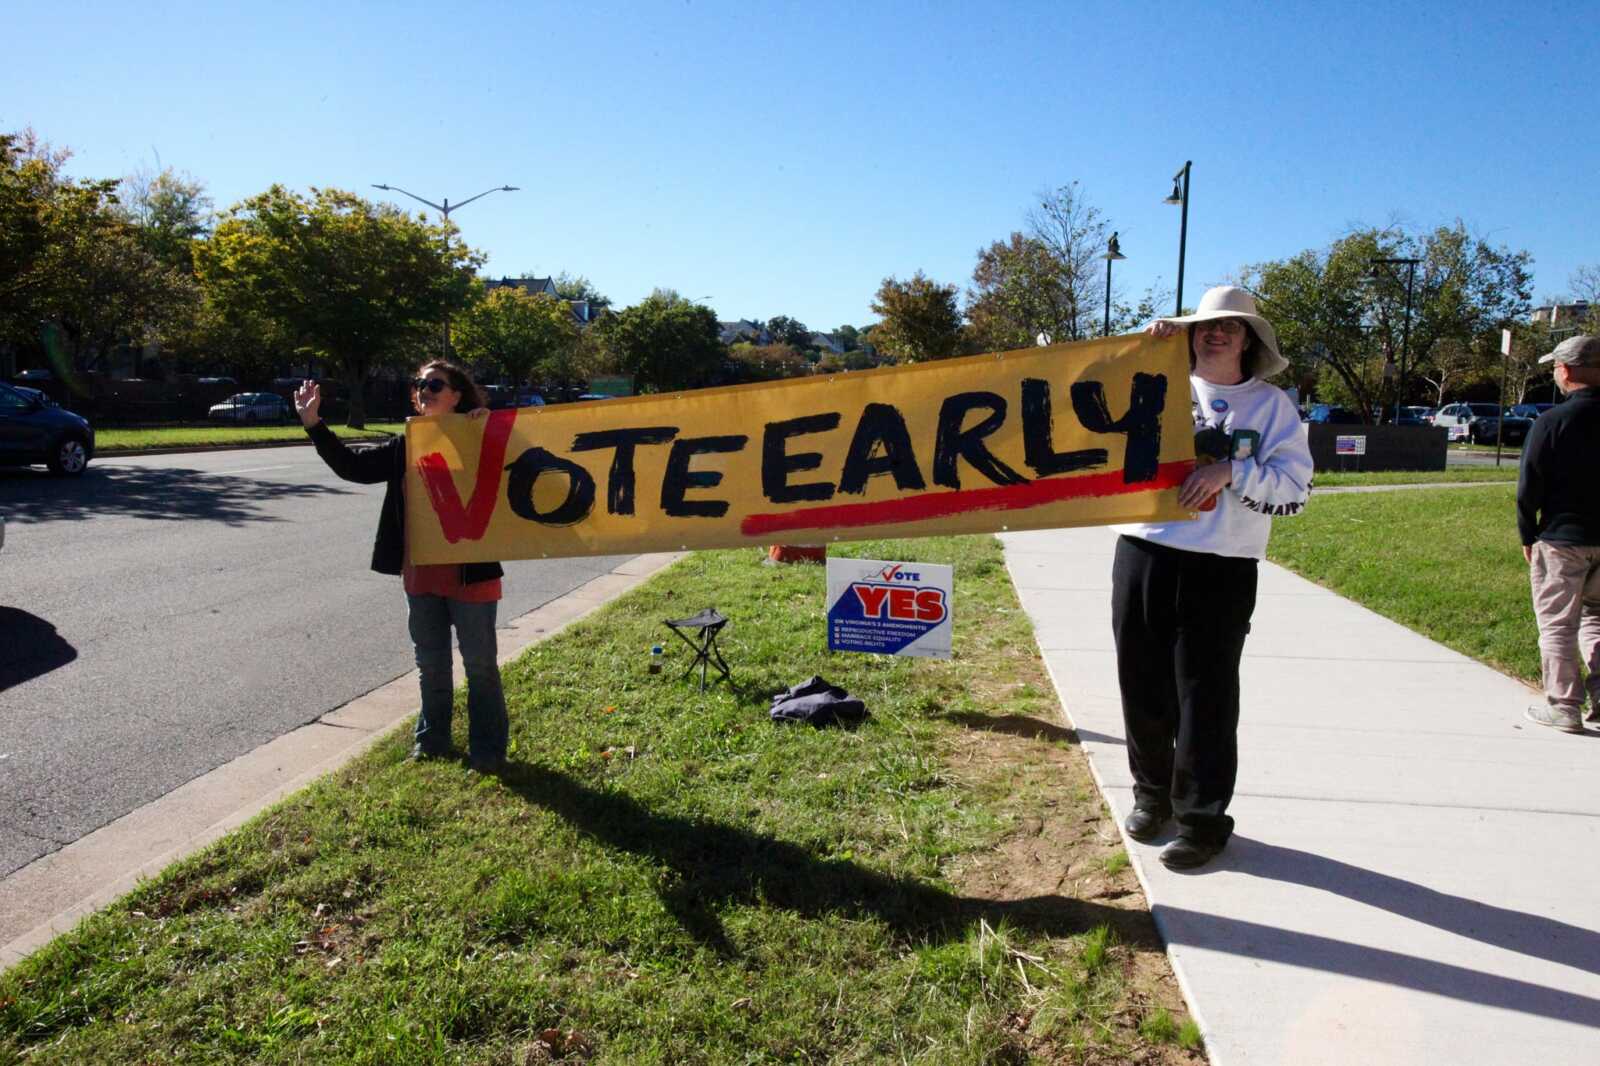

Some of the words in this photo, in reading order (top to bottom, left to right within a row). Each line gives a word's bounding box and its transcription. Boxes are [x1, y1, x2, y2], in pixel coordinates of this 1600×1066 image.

[416, 409, 749, 545] VOTE
[761, 373, 1168, 505] EARLY
[882, 564, 920, 582] VOTE
[855, 586, 943, 621] YES
